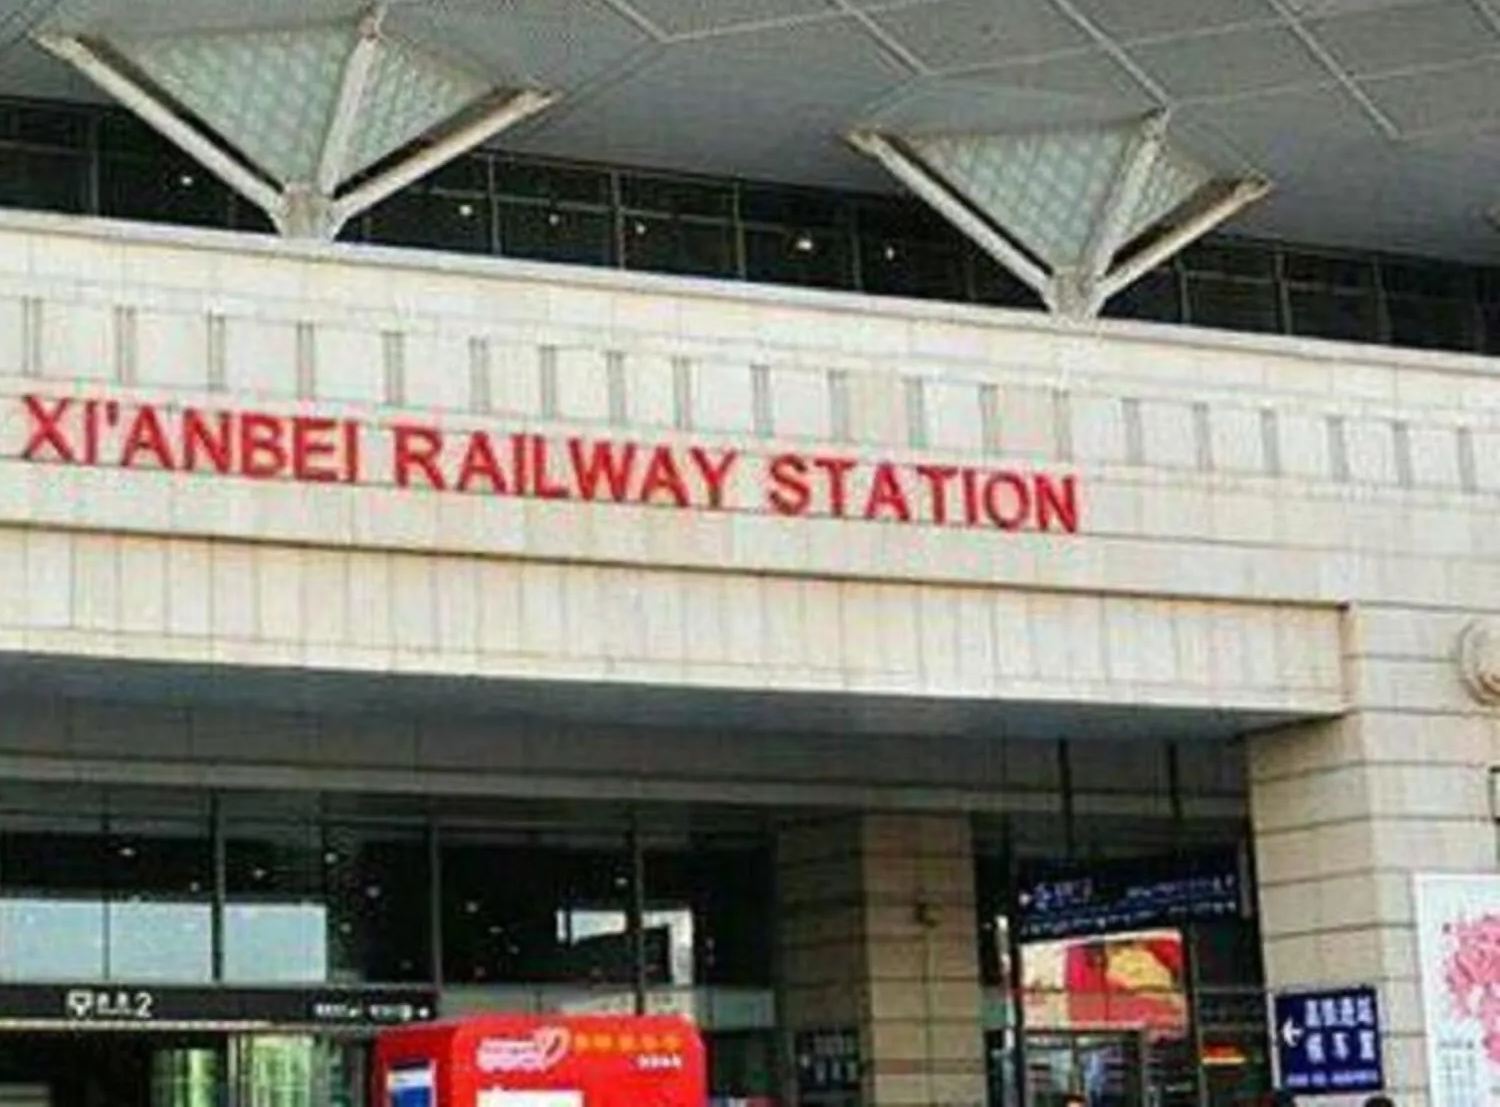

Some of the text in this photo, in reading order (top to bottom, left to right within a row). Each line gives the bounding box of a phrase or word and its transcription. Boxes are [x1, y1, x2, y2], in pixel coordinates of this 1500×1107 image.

[23, 395, 1080, 535] XI'ANBEI RAILWAY STATION
